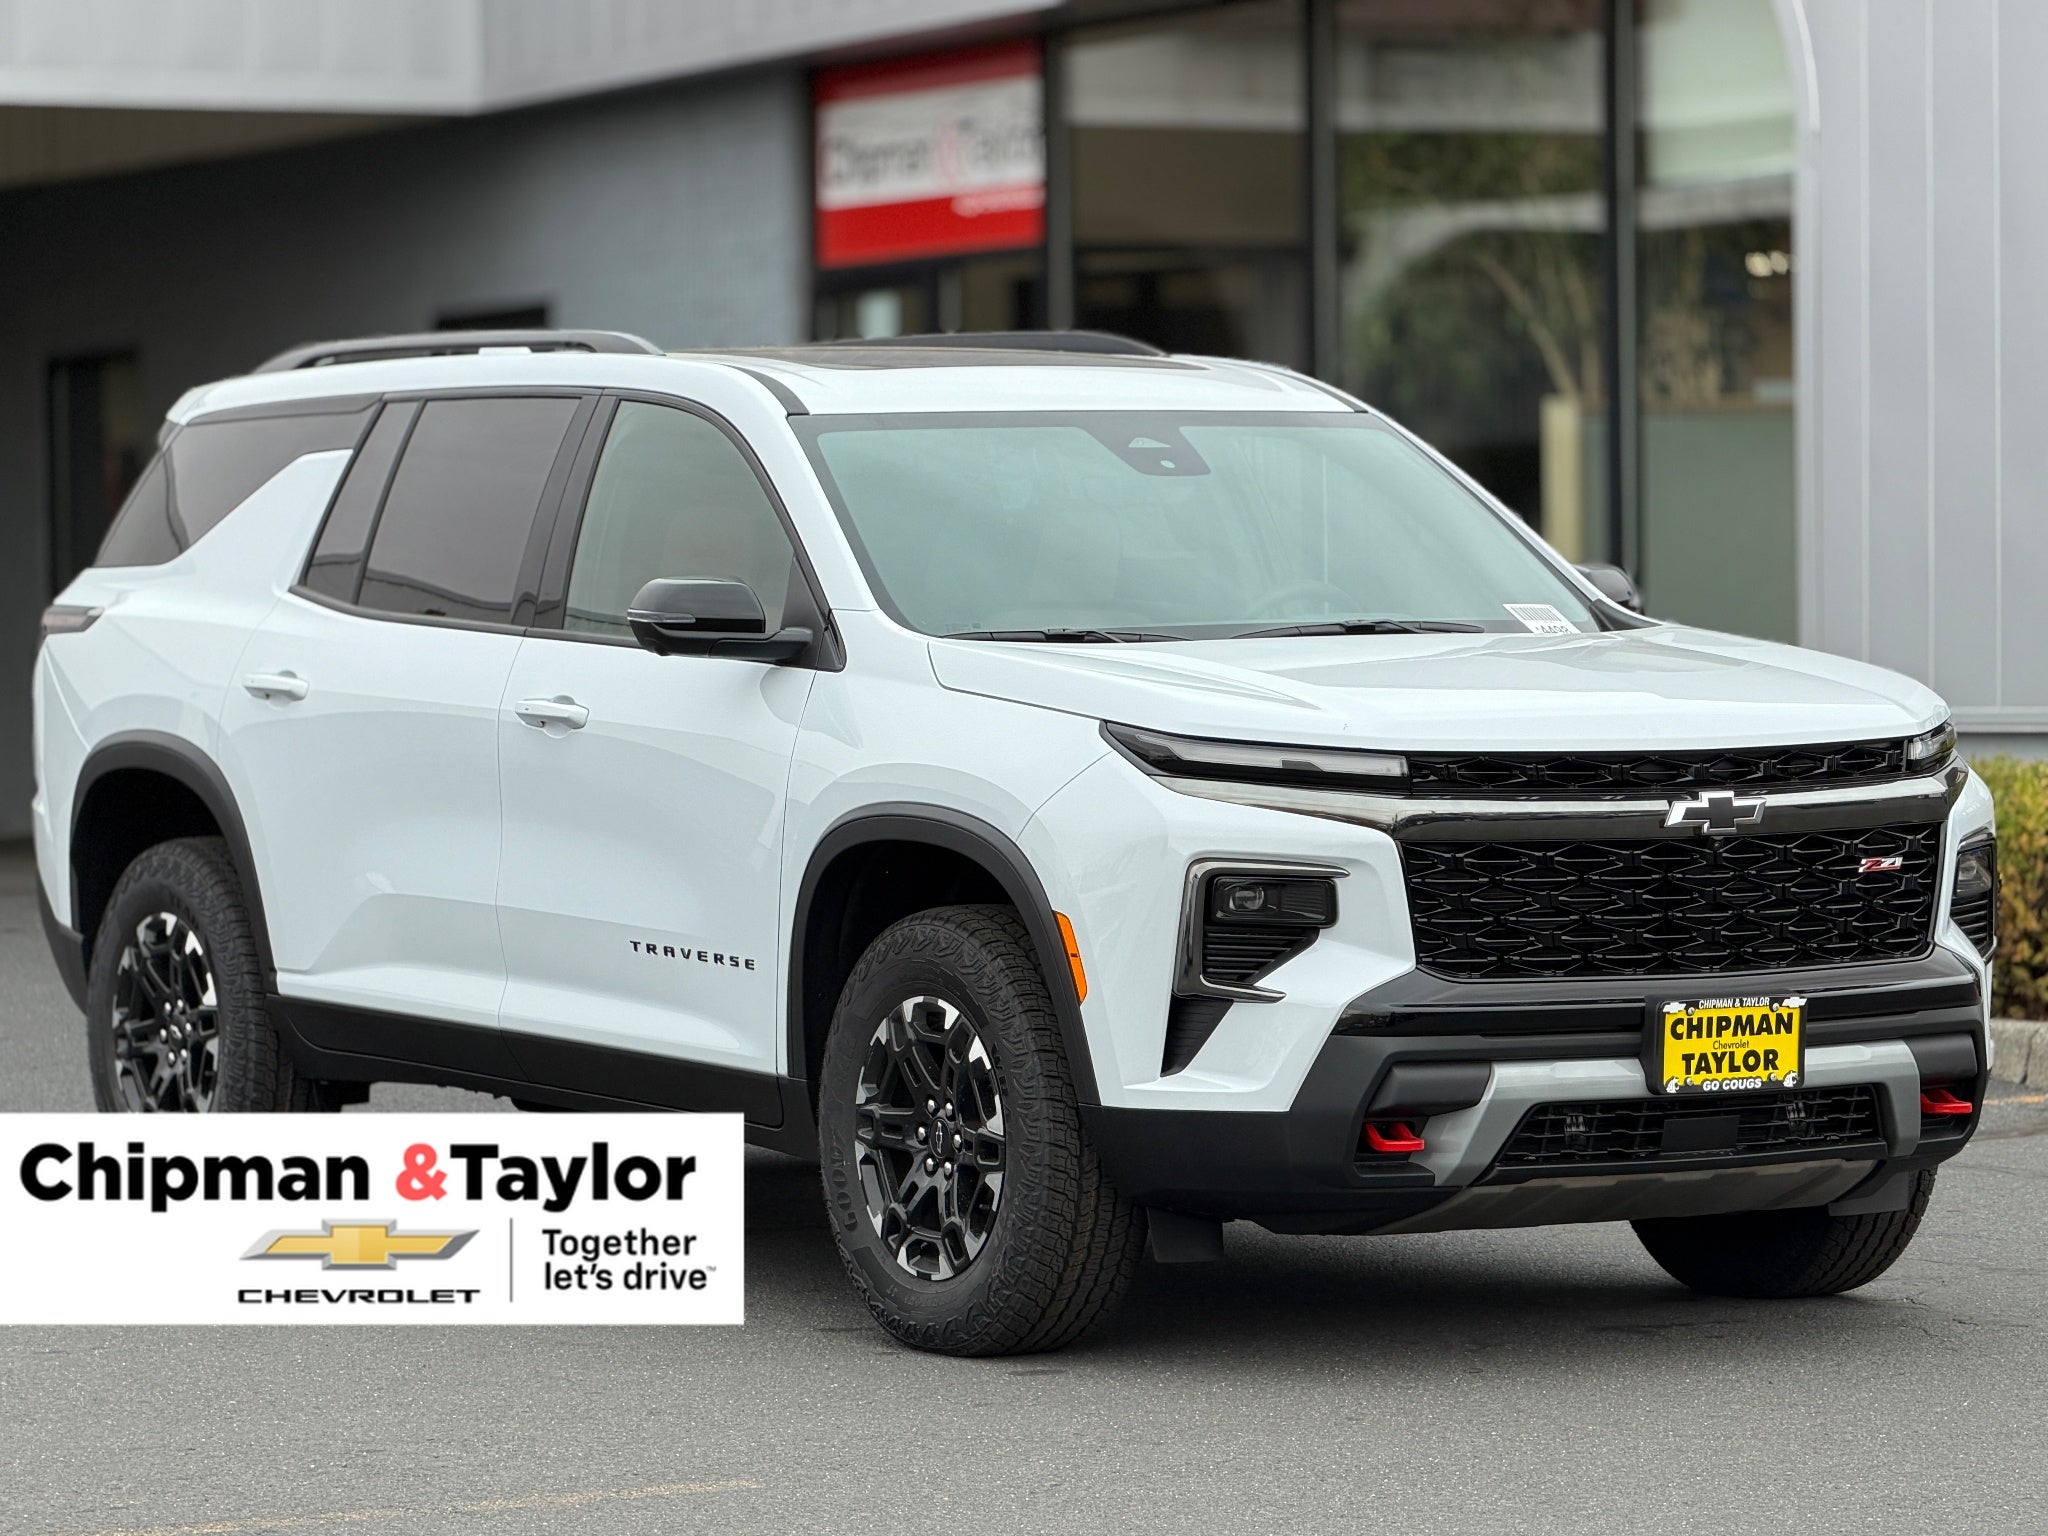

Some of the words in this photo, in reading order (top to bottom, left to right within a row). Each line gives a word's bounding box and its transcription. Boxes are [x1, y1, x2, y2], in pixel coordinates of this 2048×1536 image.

[1858, 856, 1903, 873] Z71
[629, 939, 755, 971] TRAVERSE
[1699, 998, 1733, 1010] CHIPMAN
[1734, 999, 1741, 1008] &
[1742, 996, 1770, 1007] TAYLOR
[1670, 1012, 1794, 1041] CHIPMAN
[1712, 1038, 1750, 1050] Chevrolet
[1681, 1048, 1780, 1076] TAYLOR
[1702, 1079, 1720, 1091] GO
[1722, 1077, 1763, 1090] COUGS
